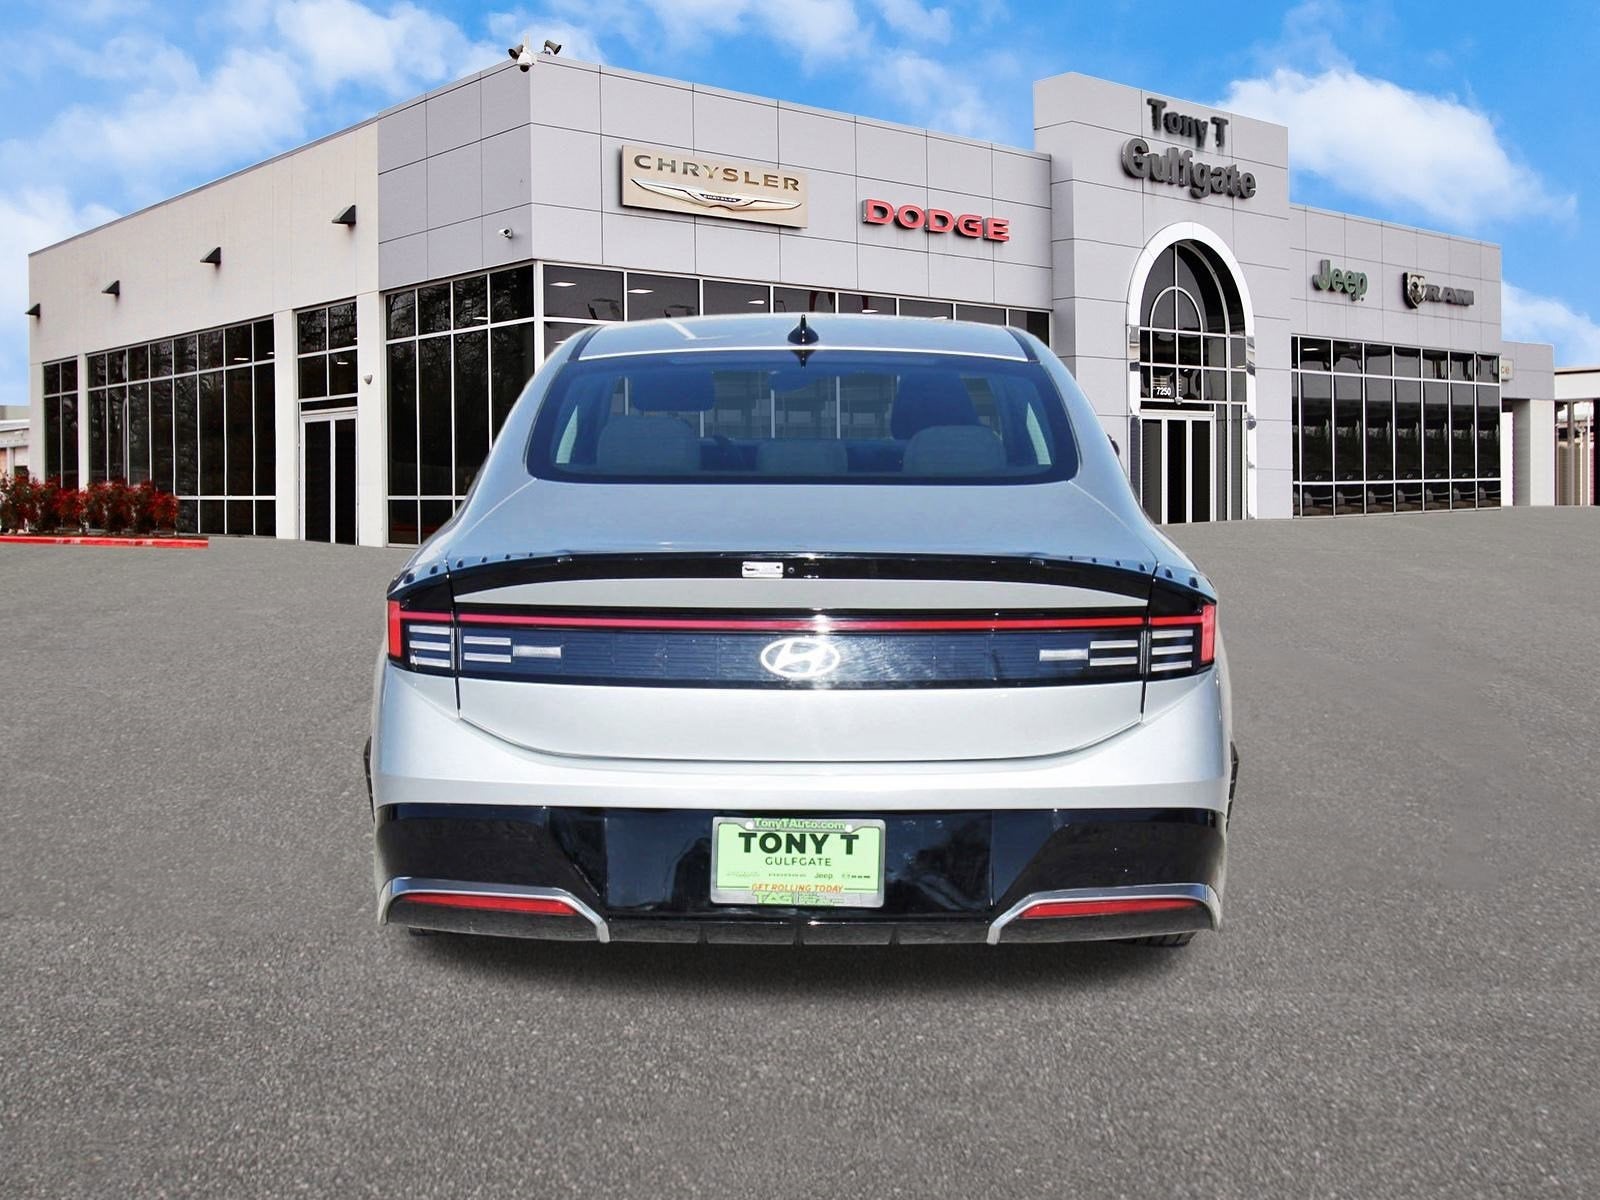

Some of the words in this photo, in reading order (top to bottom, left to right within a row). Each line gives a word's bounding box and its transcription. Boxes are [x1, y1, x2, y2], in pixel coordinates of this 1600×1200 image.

[1147, 97, 1208, 149] Tony
[1210, 116, 1229, 148] T
[633, 153, 801, 193] CHRYSLER
[1121, 137, 1257, 199] Gulfgate
[862, 198, 1011, 243] DODGE
[1312, 259, 1369, 302] Jeep
[1425, 283, 1475, 307] RAM
[1156, 387, 1172, 396] 7250
[754, 818, 847, 830] TonyTAuto.com
[738, 832, 830, 854] TONY
[840, 834, 859, 855] T
[765, 856, 832, 867] GULFGATE
[752, 883, 769, 892] GET
[771, 884, 812, 892] ROLLING
[814, 885, 843, 893] TODAY
